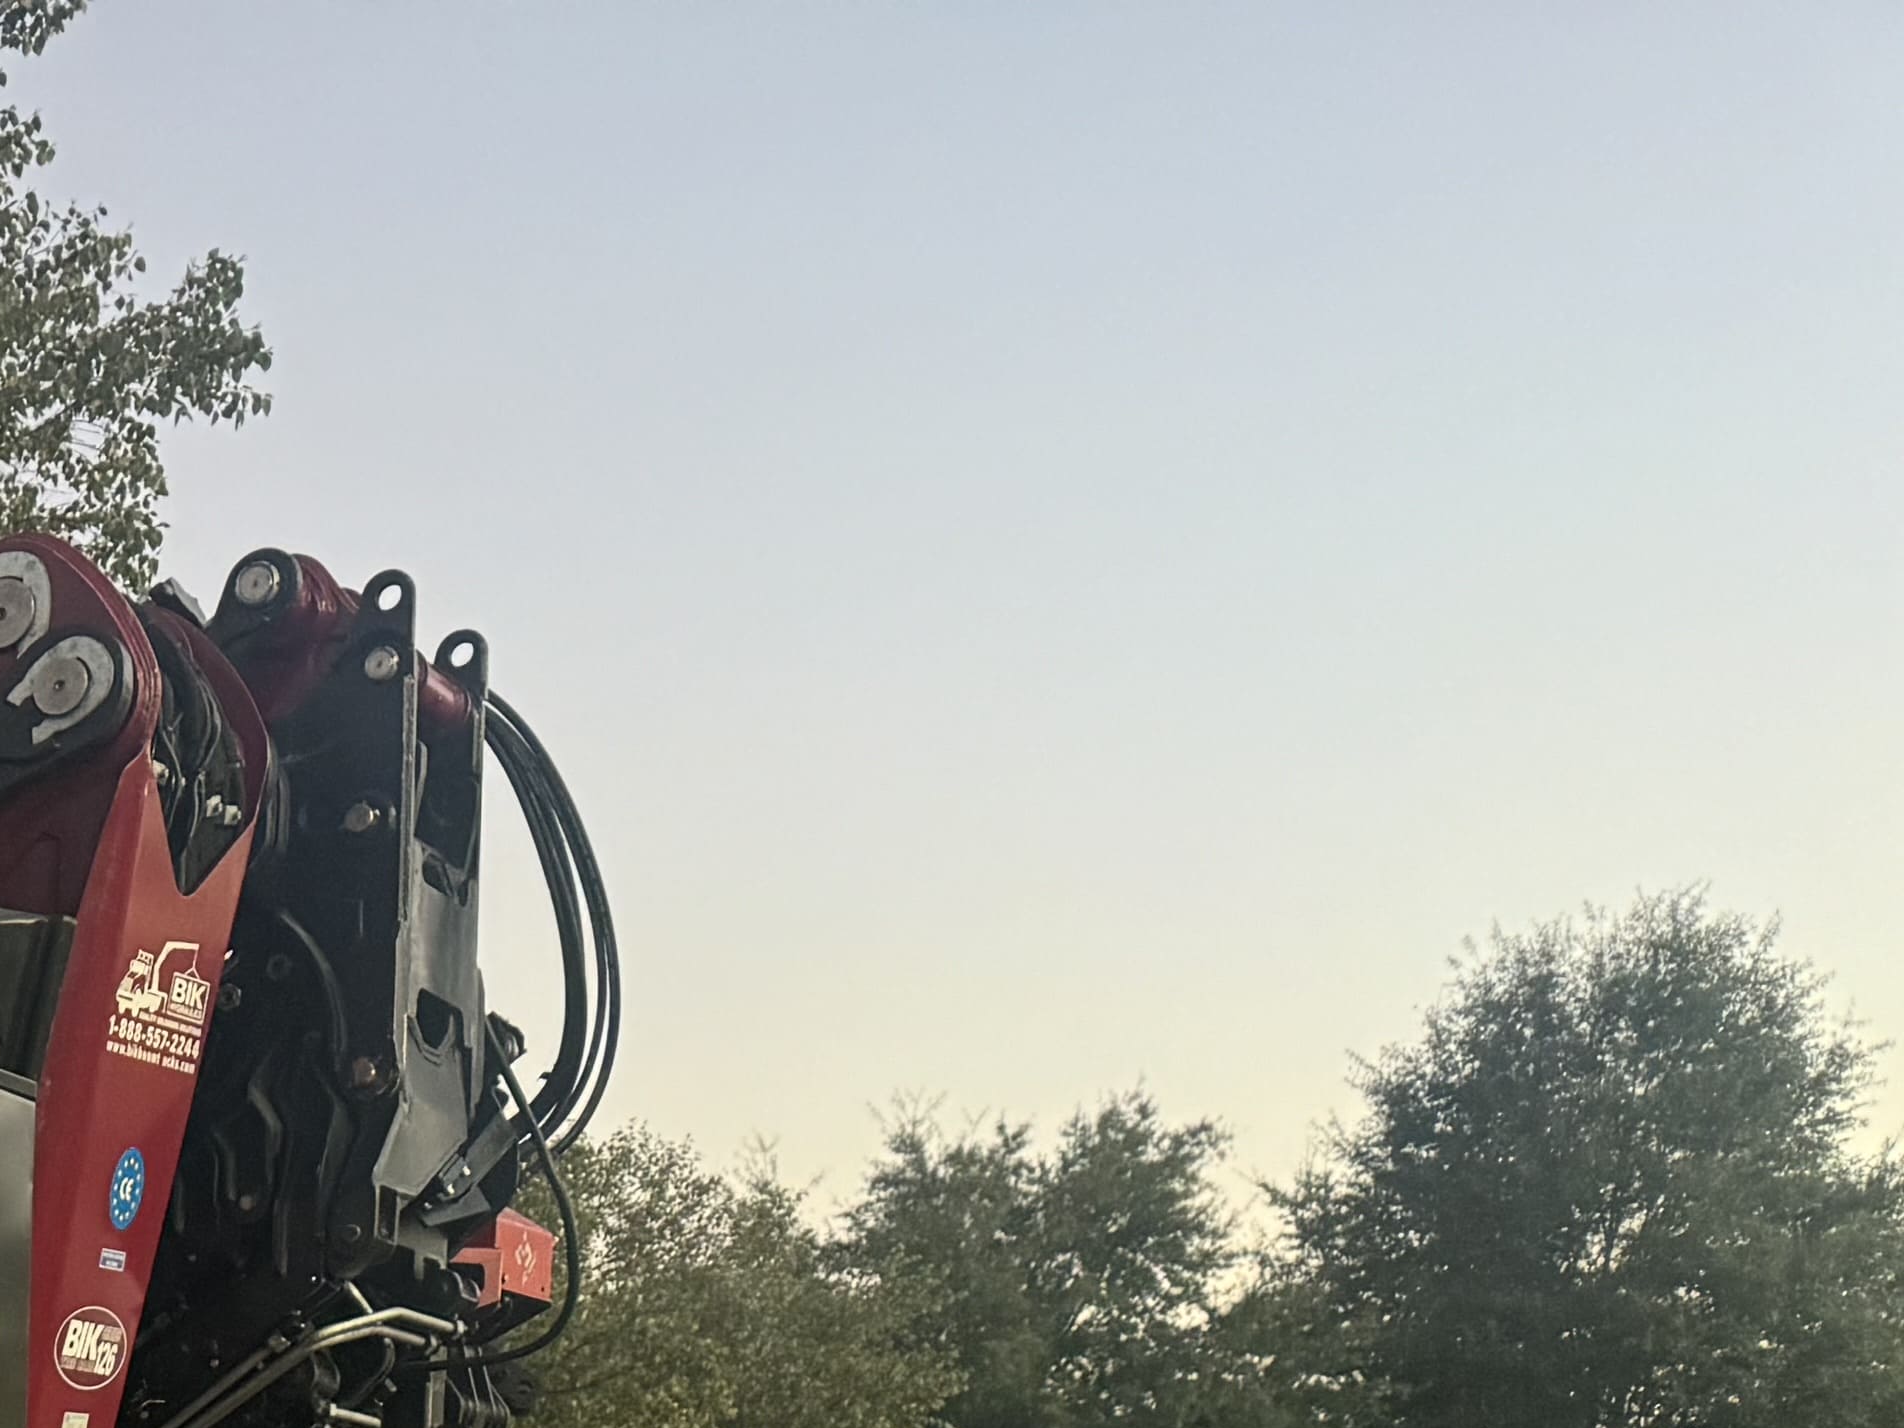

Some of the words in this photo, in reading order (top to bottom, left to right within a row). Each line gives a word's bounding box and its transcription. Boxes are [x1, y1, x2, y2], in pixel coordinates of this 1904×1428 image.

[171, 977, 206, 1010] BIK
[119, 1177, 134, 1202] CE
[62, 1319, 104, 1360] BIK
[94, 1341, 119, 1377] 126
